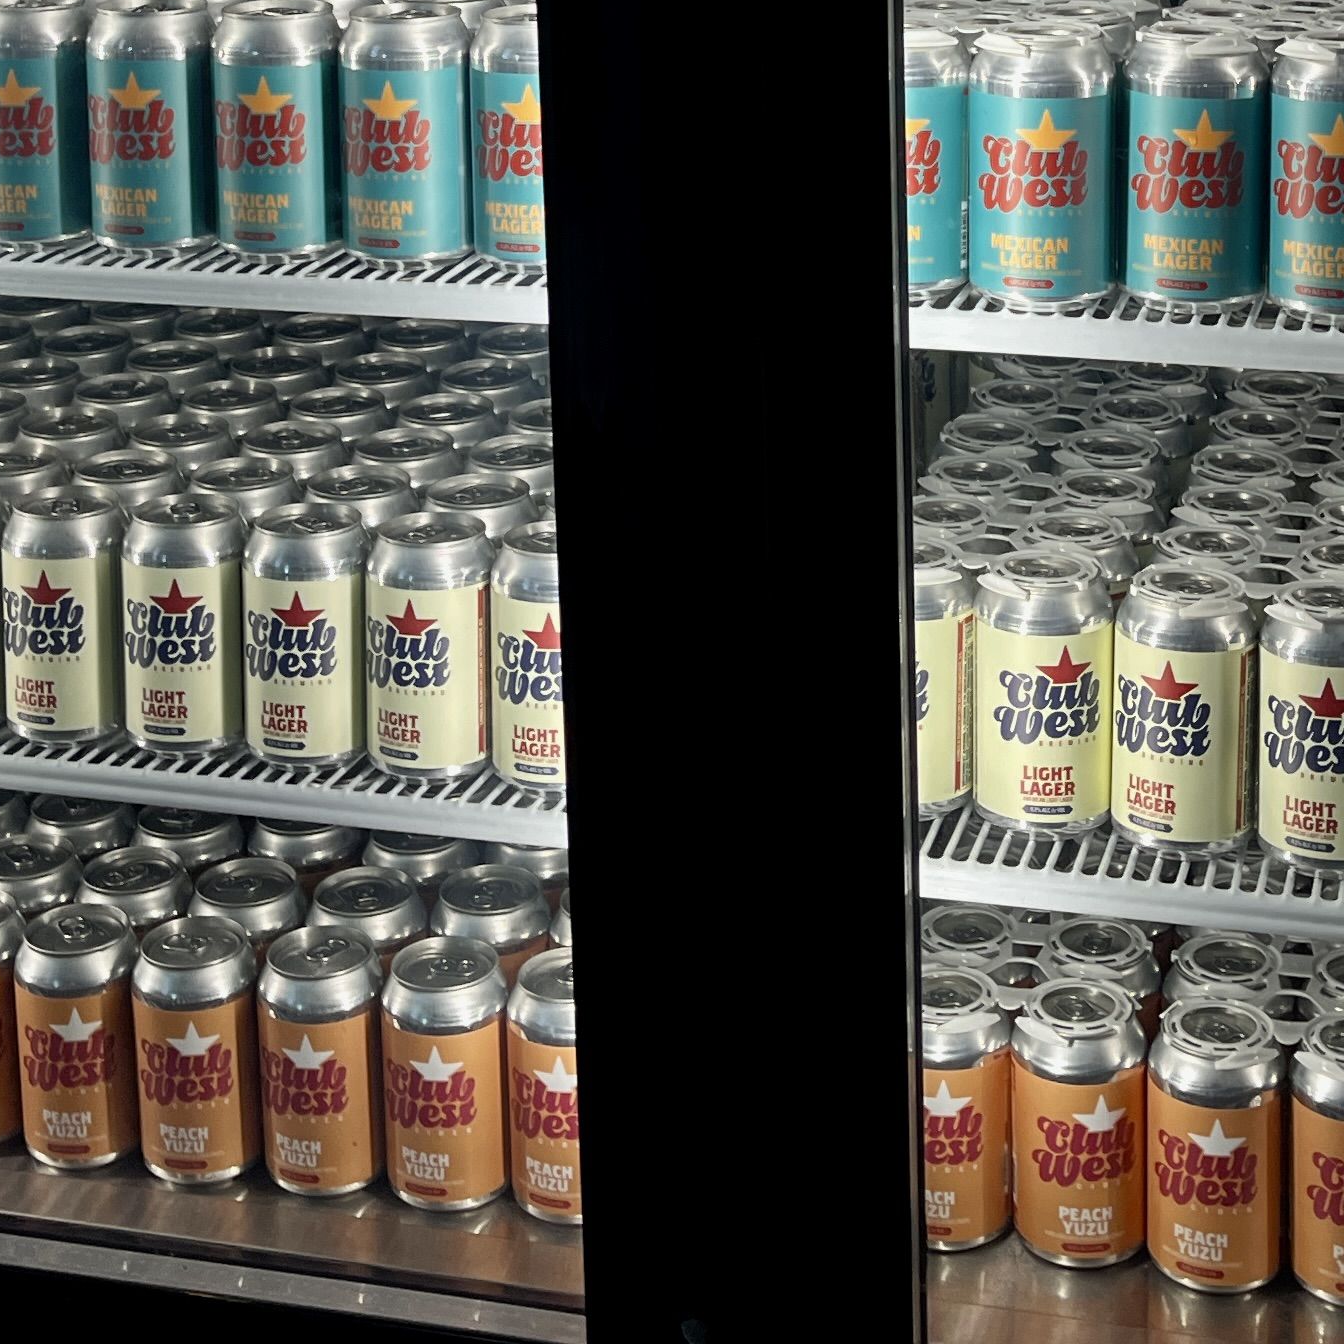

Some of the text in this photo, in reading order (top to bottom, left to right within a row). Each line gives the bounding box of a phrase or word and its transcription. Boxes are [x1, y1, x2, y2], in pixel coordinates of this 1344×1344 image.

[216, 100, 305, 138] Club
[217, 135, 306, 171] West
[983, 135, 1088, 176] Club
[223, 192, 289, 209] MEXICAN
[978, 173, 1088, 210] West
[230, 209, 278, 224] LAGER
[991, 233, 1069, 253] MEXICAN
[999, 251, 1057, 269] LAGER
[127, 598, 214, 640] Club
[126, 630, 216, 670] West
[142, 687, 185, 704] LIGHT
[999, 669, 1099, 709] Club
[141, 701, 188, 720] LAGER
[994, 705, 1099, 745] West
[1023, 765, 1073, 781] LIGHT
[1020, 780, 1075, 796] LAGER
[142, 1040, 231, 1076] Club
[142, 1068, 233, 1104] West
[388, 1060, 476, 1101] Club
[388, 1094, 477, 1131] West
[160, 1123, 208, 1140] PEACH
[164, 1138, 204, 1154] YUZU
[1038, 1115, 1135, 1155] Club
[402, 1146, 449, 1167] PEACH
[1158, 1129, 1258, 1176] Club
[405, 1162, 445, 1181] YUZU
[1033, 1149, 1135, 1187] West
[1155, 1163, 1257, 1207] West
[1059, 1205, 1113, 1222] PEACH
[1063, 1219, 1108, 1235] YUZU
[1174, 1224, 1228, 1247] PEACH
[1178, 1241, 1223, 1261] YUZU
